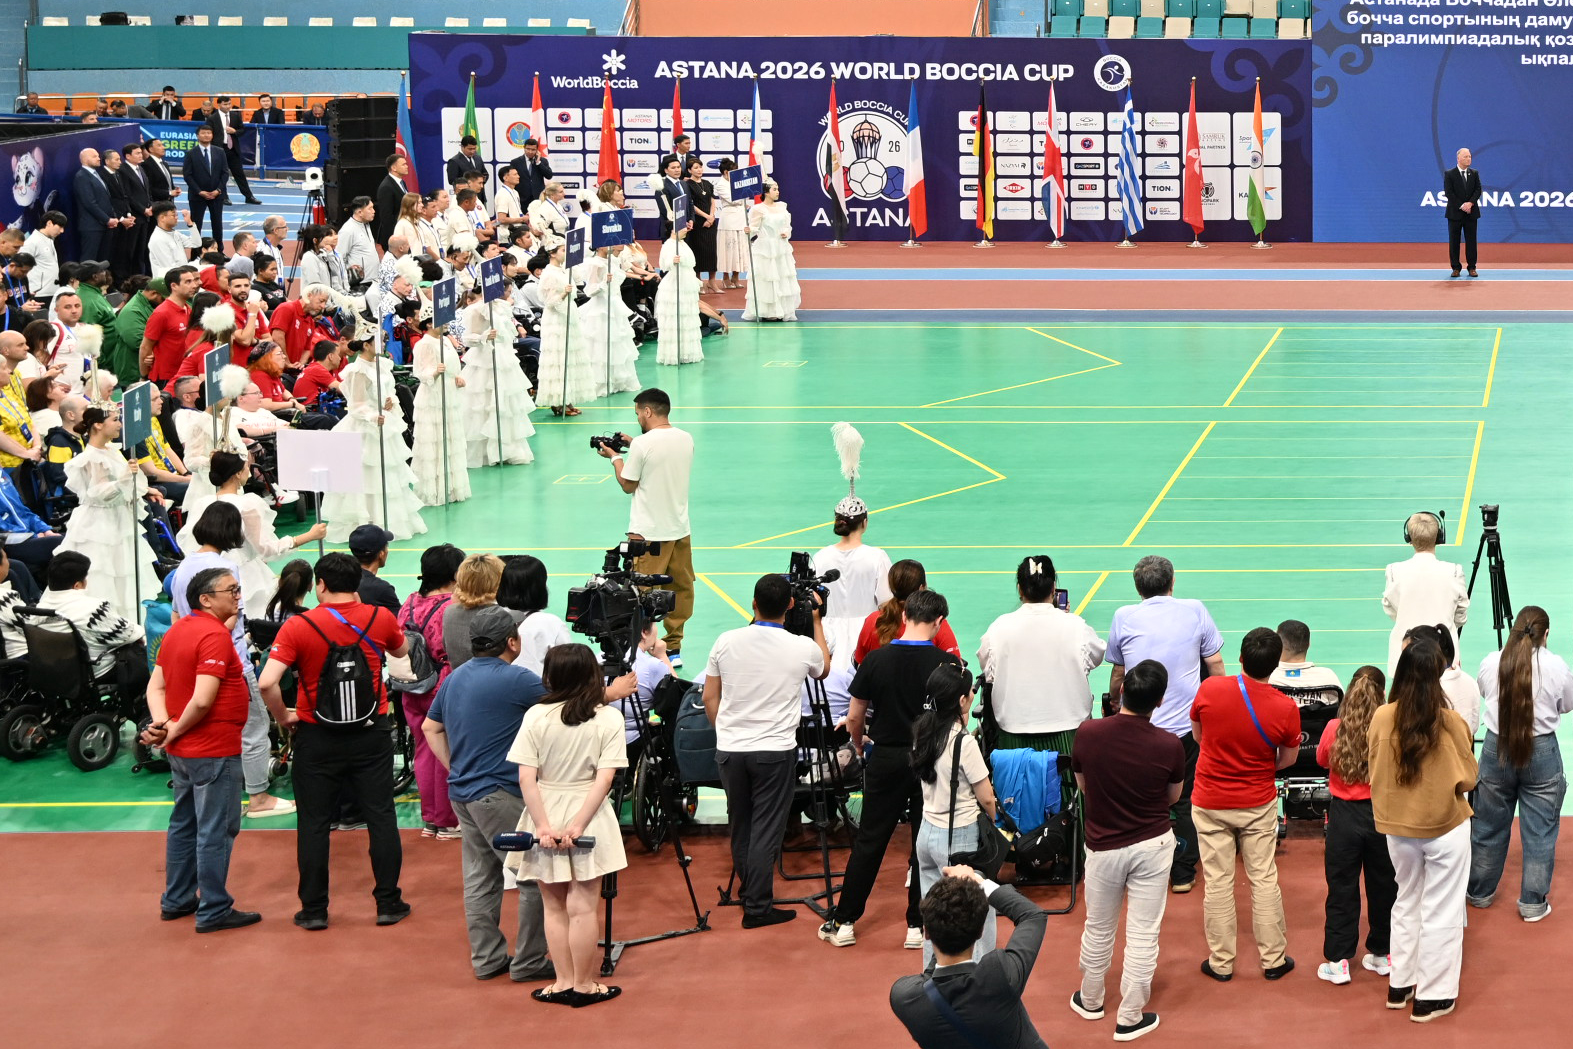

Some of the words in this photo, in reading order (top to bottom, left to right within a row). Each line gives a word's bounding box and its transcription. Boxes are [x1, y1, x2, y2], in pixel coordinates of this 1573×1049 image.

[1347, 11, 1404, 25] бочча
[1408, 13, 1521, 29] спортының
[1361, 33, 1540, 48] паралимпиадалық
[654, 60, 754, 79] ASTANA
[760, 61, 826, 79] 2026
[830, 61, 921, 80] WORLD
[925, 62, 1020, 81] BOCCIA
[1023, 63, 1075, 81] CUP
[551, 75, 639, 89] WorldBoccia
[854, 100, 893, 114] BOCCIA
[888, 141, 900, 152] 26
[1420, 190, 1516, 207] ASNA
[811, 207, 911, 227] ATAN
[602, 223, 623, 234] Slovakia
